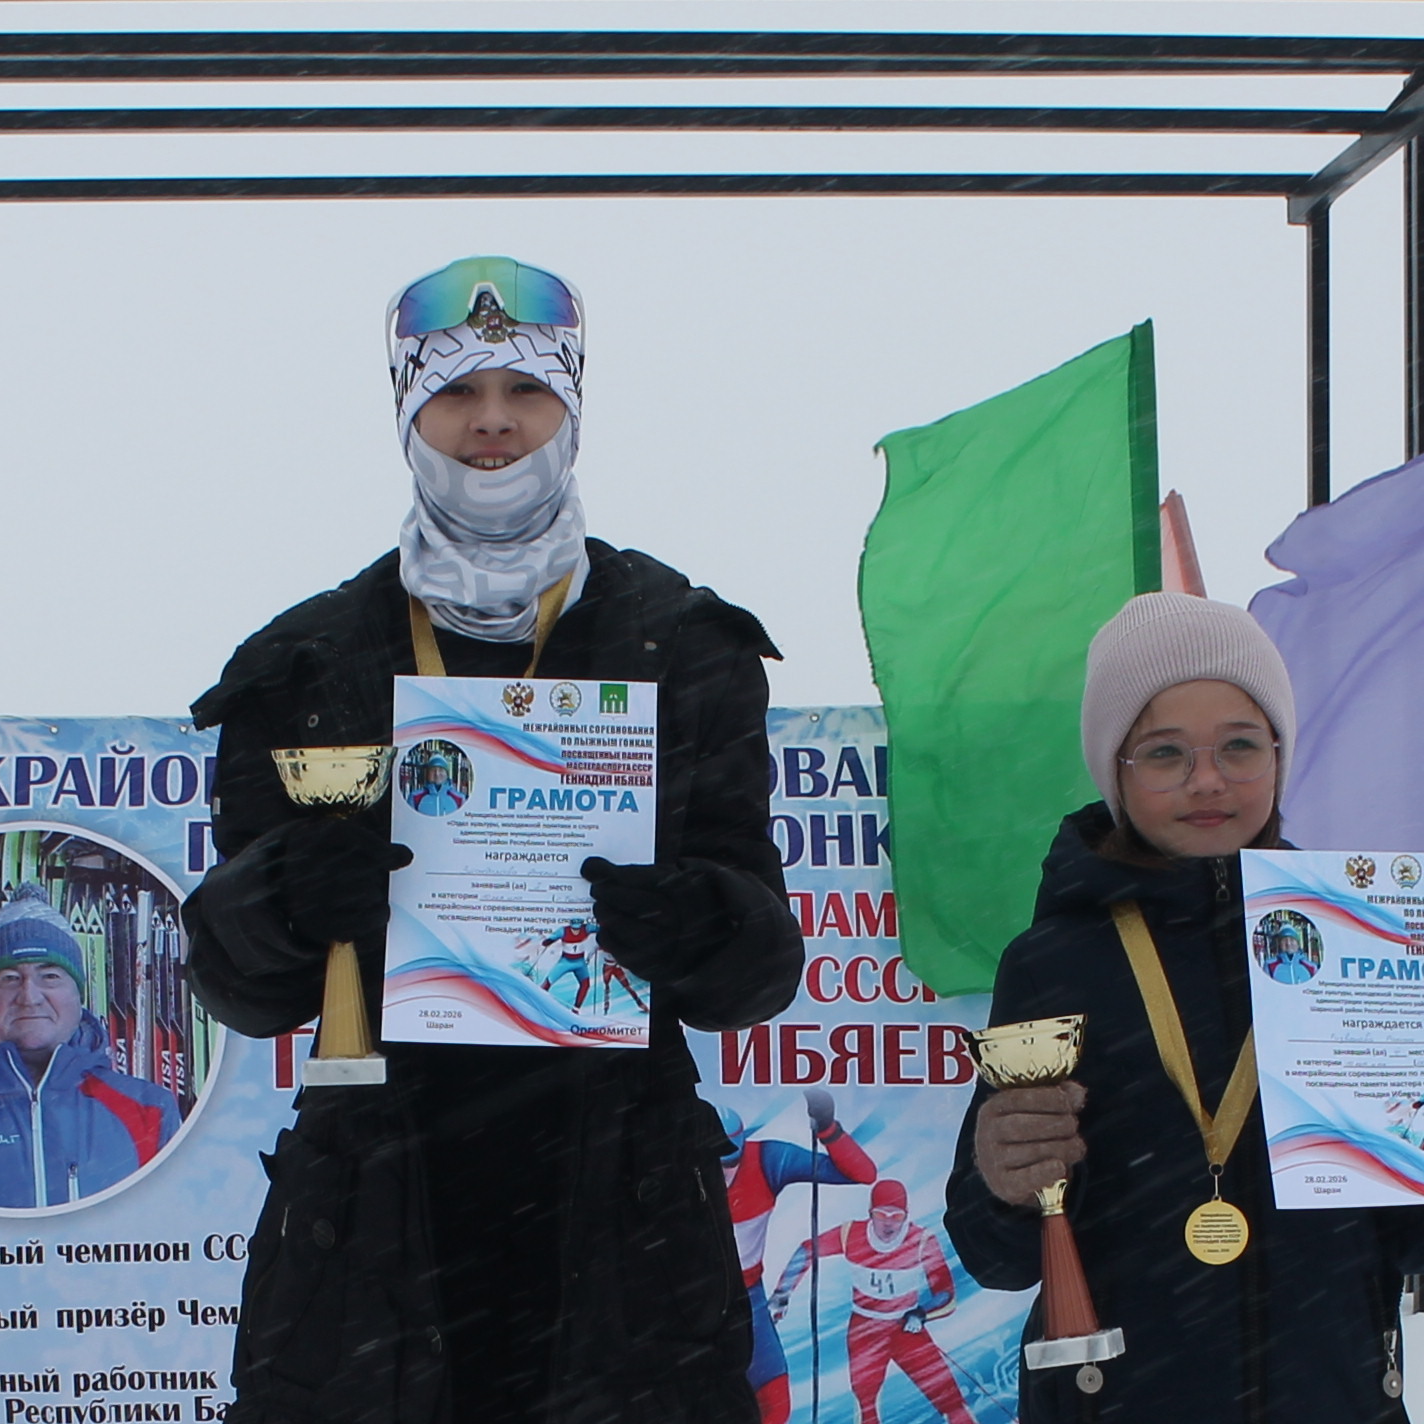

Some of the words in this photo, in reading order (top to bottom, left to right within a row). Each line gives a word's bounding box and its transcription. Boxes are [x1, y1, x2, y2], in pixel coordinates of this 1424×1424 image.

[489, 788, 639, 813] ГРАМОТА
[485, 851, 569, 864] награждается
[806, 956, 936, 1003] ССС
[570, 1024, 642, 1038] Оргкомитет
[1342, 1019, 1423, 1030] награждается
[57, 1237, 190, 1263] чемпион
[204, 1234, 249, 1262] СС
[871, 1271, 894, 1294] 41
[57, 1303, 165, 1333] призёр
[74, 1367, 217, 1397] работник
